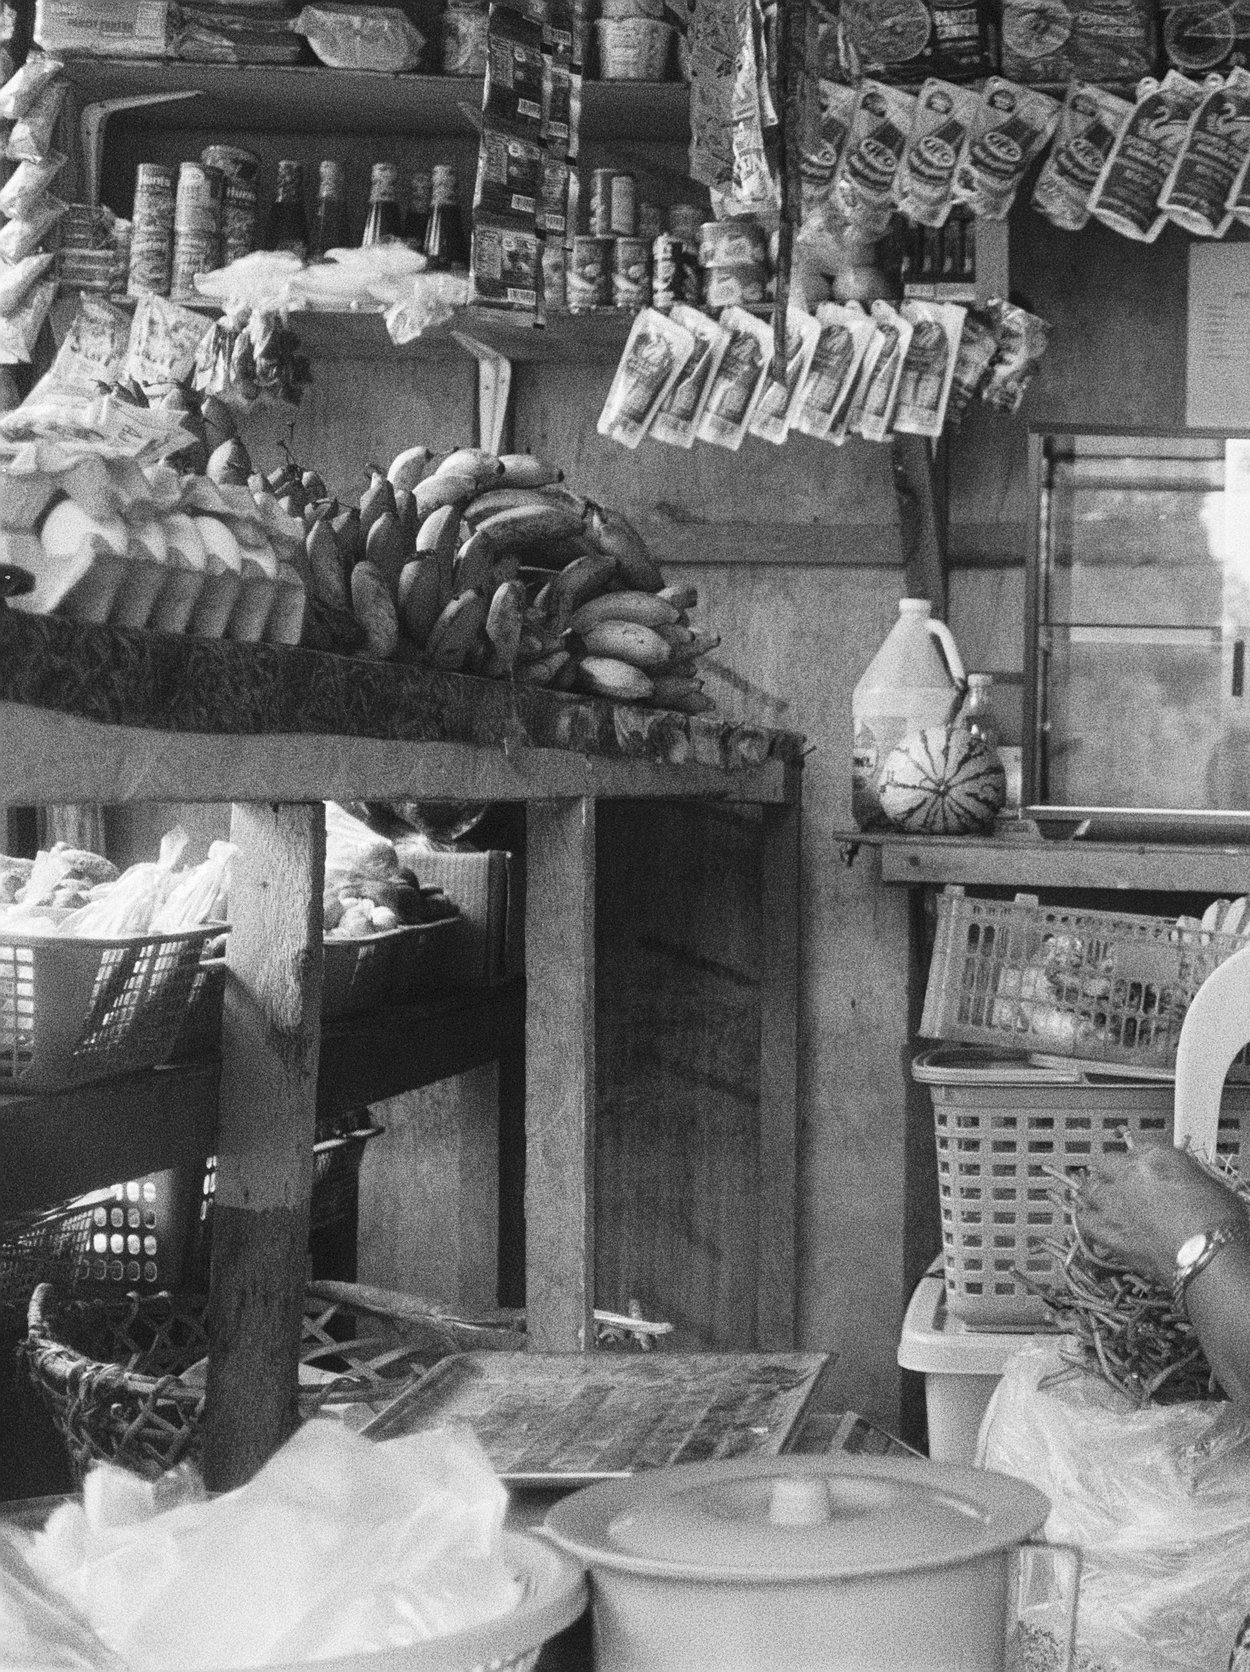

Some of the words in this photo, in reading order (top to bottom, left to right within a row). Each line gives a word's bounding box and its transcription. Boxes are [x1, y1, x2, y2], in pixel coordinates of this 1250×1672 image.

[865, 140, 895, 168] UFC
[921, 137, 951, 165] UFC
[988, 134, 1017, 159] UFC
[1071, 140, 1103, 169] UFC
